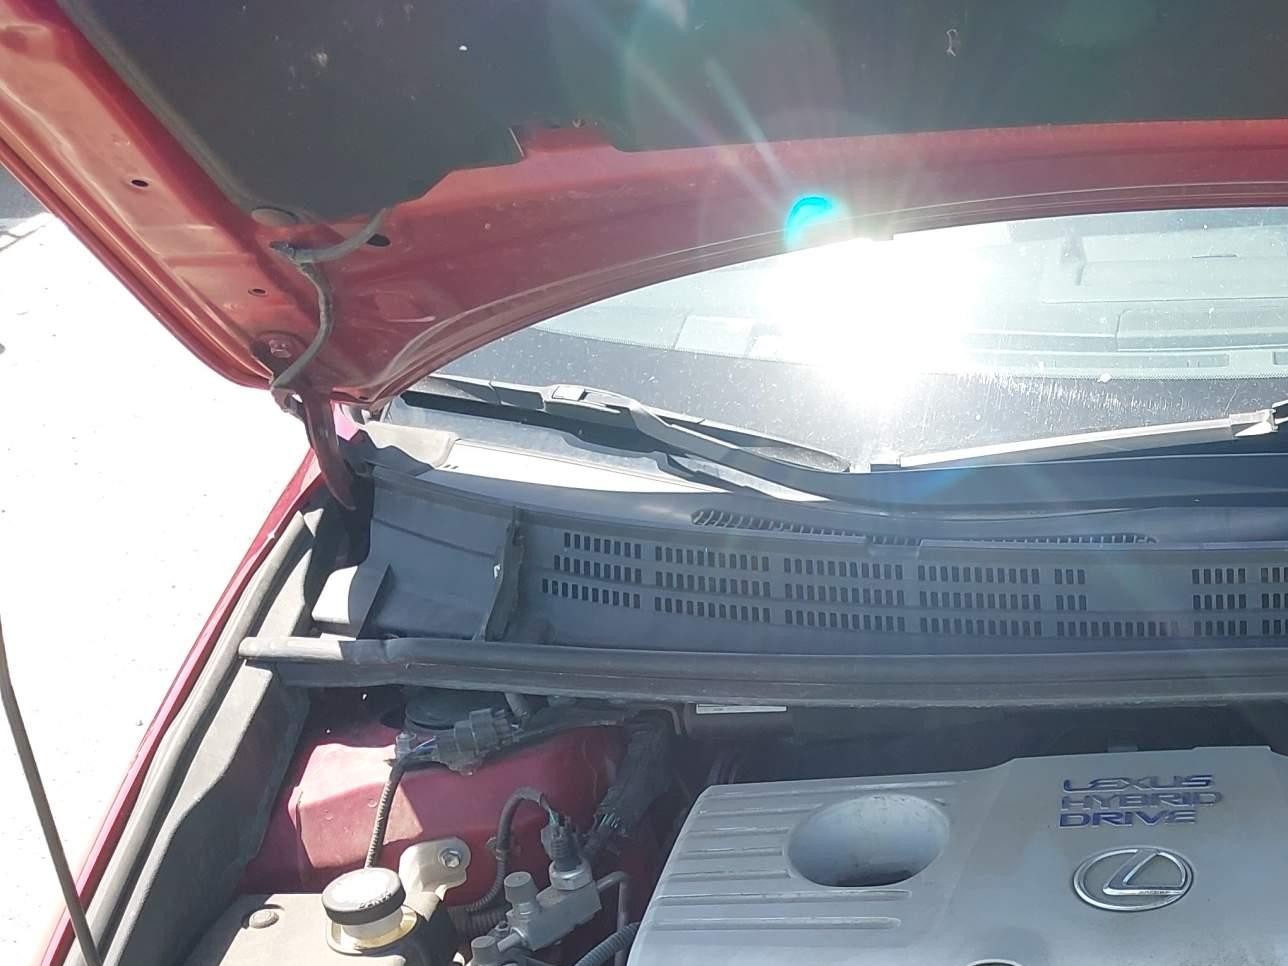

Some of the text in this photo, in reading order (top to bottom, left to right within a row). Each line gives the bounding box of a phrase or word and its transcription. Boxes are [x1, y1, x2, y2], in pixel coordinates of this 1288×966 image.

[1063, 775, 1214, 793] LEXUS
[1060, 791, 1223, 811] HYBRID
[1059, 809, 1197, 828] DRIVE
